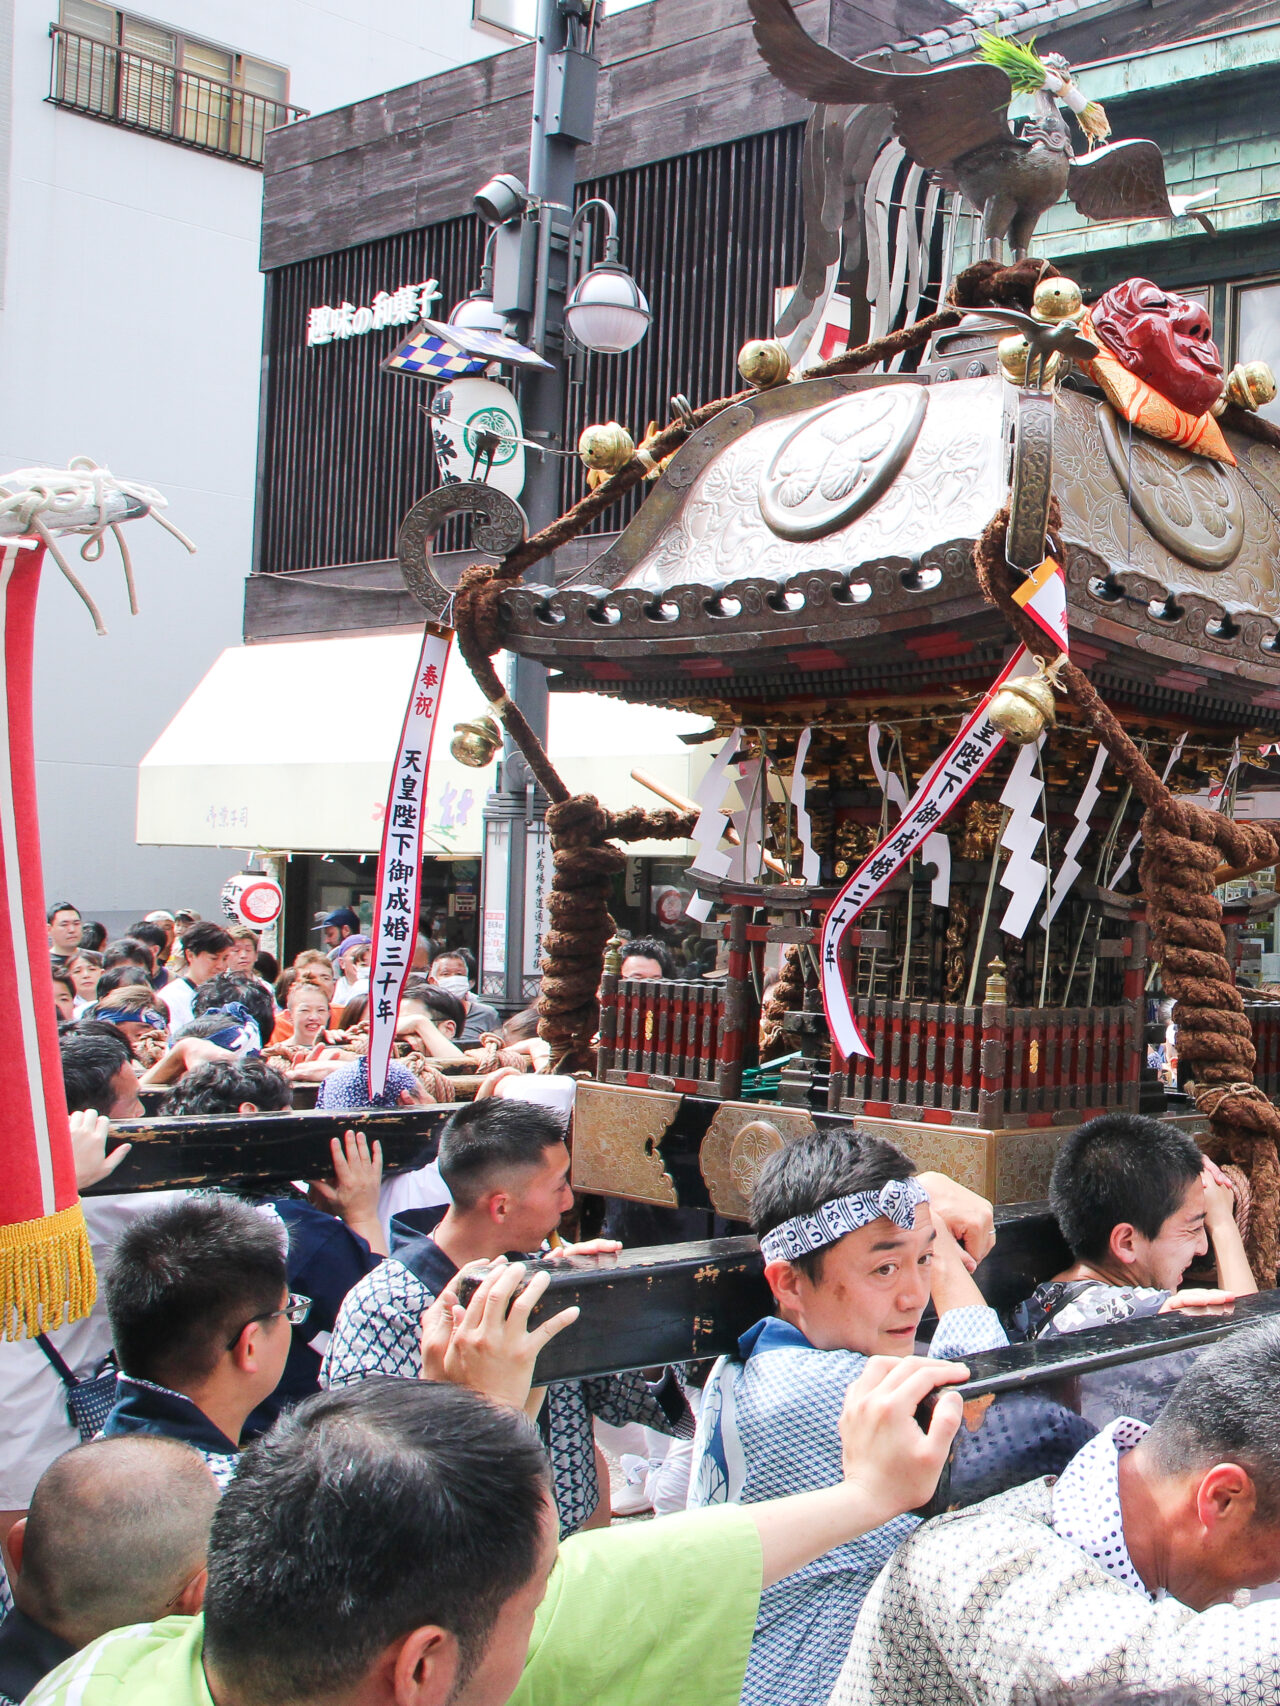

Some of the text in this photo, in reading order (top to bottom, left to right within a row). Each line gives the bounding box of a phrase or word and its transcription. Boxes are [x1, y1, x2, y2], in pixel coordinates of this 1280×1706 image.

[308, 278, 443, 347] 趣味の和菓子
[376, 664, 438, 1024] 奉祝 天皇陛下御成婚三十年
